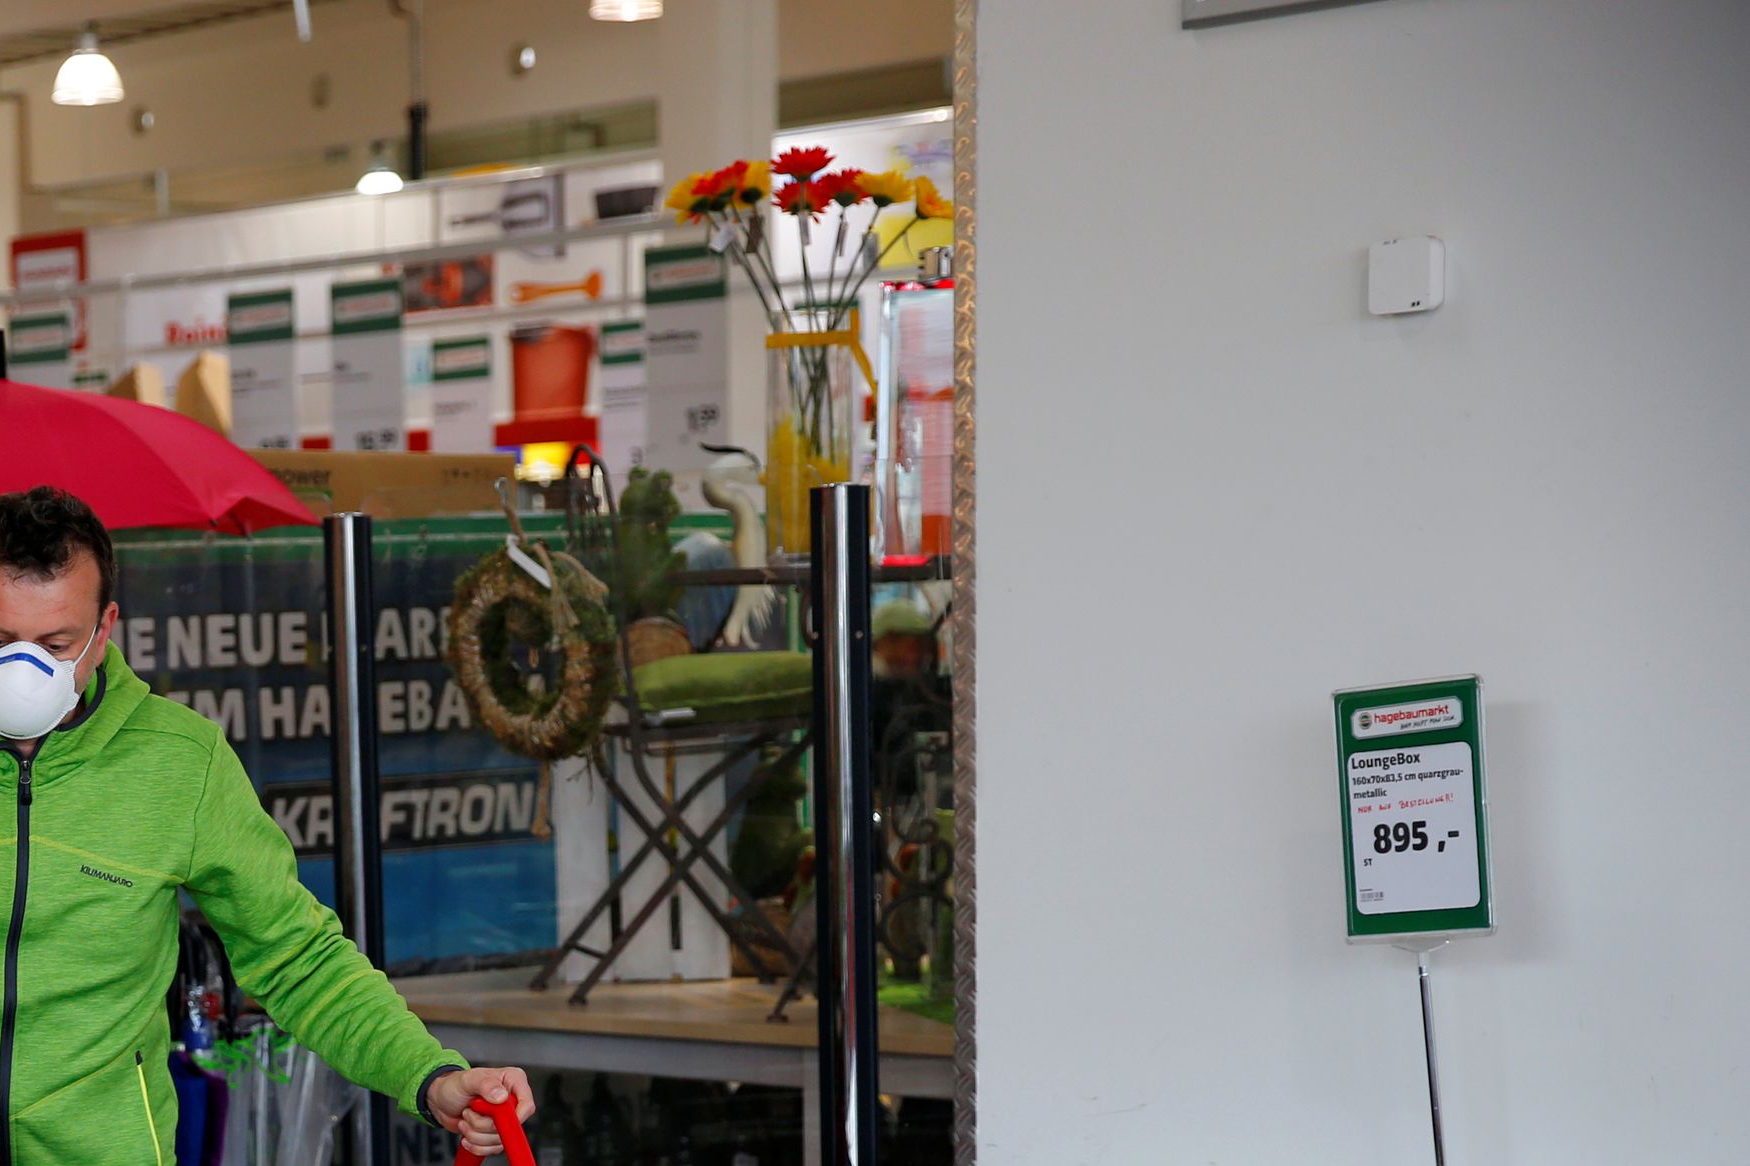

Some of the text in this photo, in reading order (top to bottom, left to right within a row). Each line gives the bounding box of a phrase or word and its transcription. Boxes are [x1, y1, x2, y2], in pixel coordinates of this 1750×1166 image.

[166, 610, 308, 670] NEUE
[1373, 704, 1450, 725] hagebaumarkt
[1351, 752, 1421, 771] LoungeBox
[1404, 773, 1417, 781] cm
[1418, 768, 1464, 782] quarzgrau-
[1353, 787, 1388, 800] metallic
[271, 780, 536, 851] KRFTRON
[80, 864, 134, 888] KILIMANJARO
